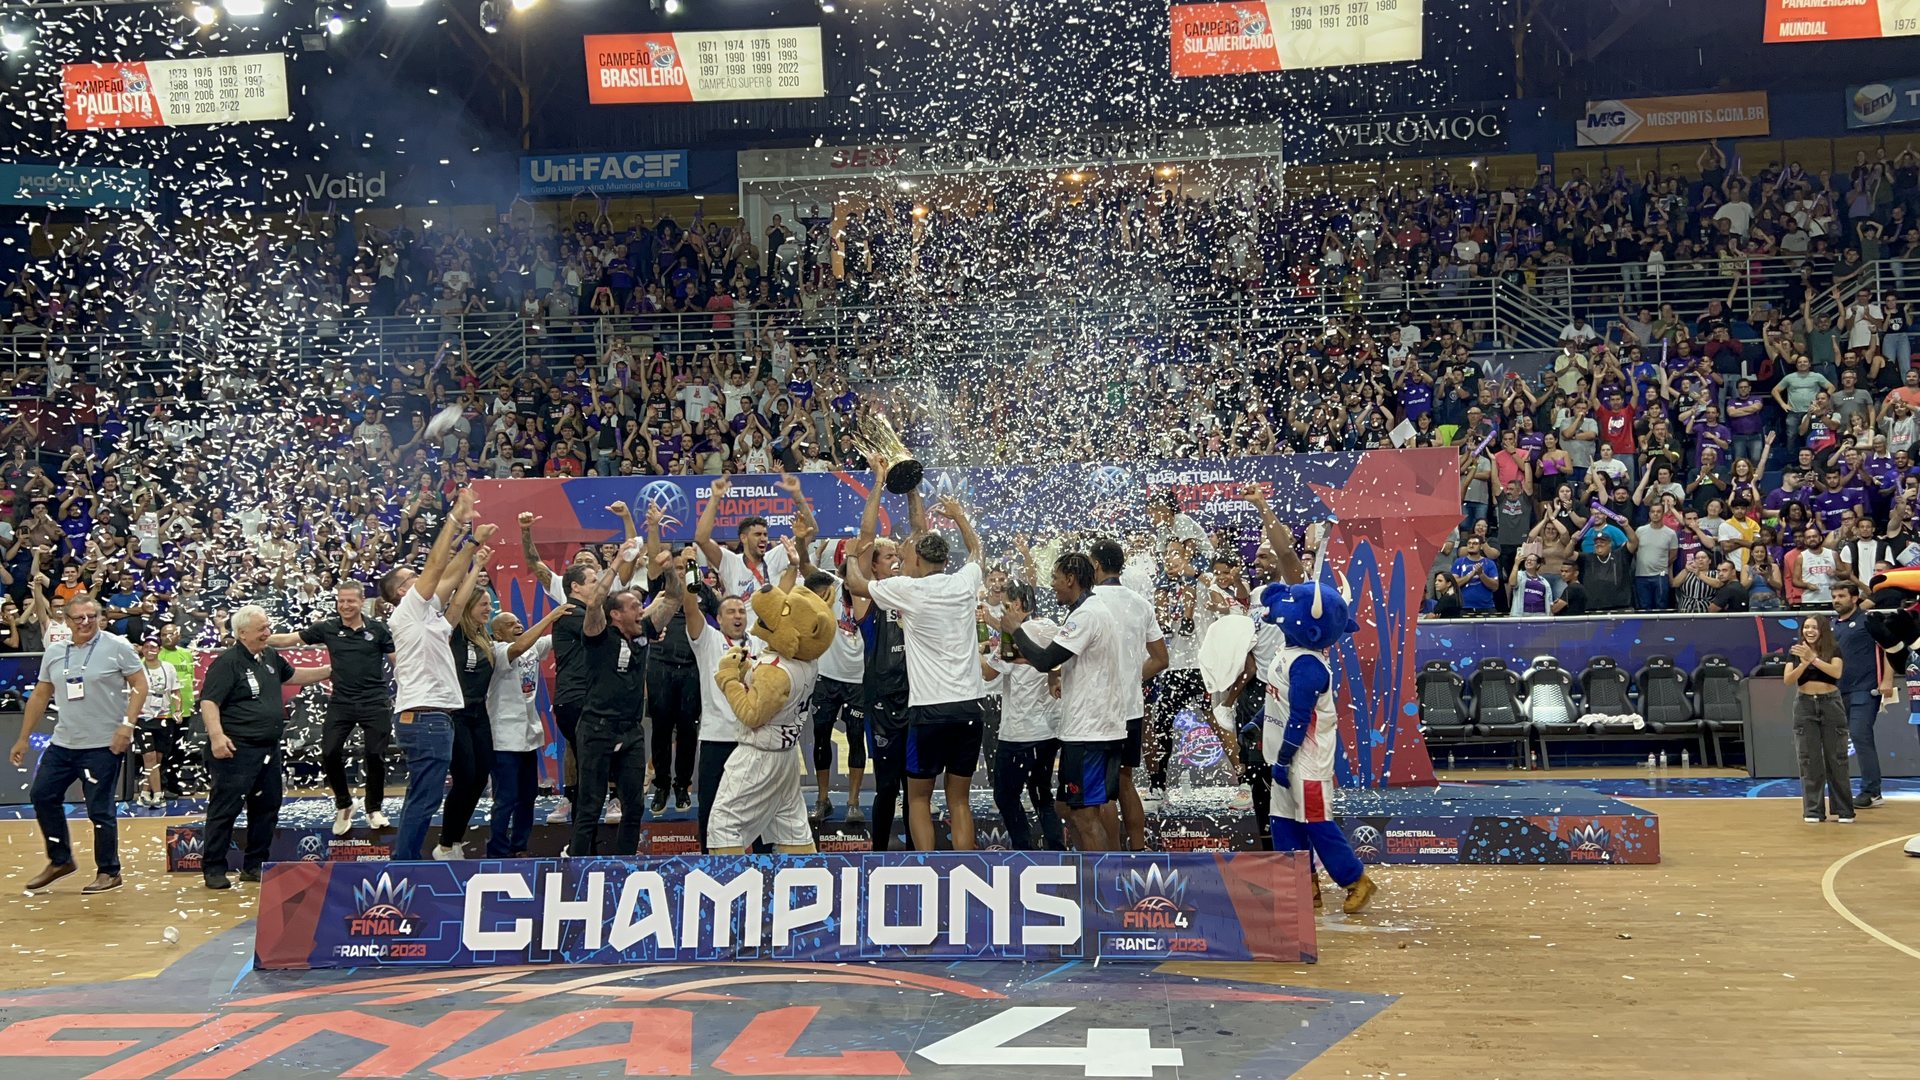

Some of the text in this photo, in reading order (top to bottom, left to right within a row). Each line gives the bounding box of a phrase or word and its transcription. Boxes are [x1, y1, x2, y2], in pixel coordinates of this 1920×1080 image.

[1291, 0, 1397, 18] 1974 1975 1977 1980
[1291, 16, 1369, 30] 1990 1991 2018
[1779, 21, 1828, 37] MUNDIAL
[1894, 18, 1916, 30] 1975
[698, 38, 797, 52] 1971 1974 1975 1980
[1184, 33, 1274, 53] SULAMERICANO
[599, 50, 650, 67] CAMPEÃO
[699, 50, 798, 64] 1981 1990 1991 1993
[193, 67, 212, 77] 1975
[218, 65, 237, 76] 1976
[243, 64, 262, 74] 1977
[699, 62, 799, 76] 1997 1998 1999 2022
[194, 78, 213, 89] 1990
[600, 67, 684, 88] BRASILEIRO
[699, 75, 799, 90] CAMPEÃO SUPER 8 2020
[194, 89, 214, 100] 2006
[219, 88, 239, 99] 2007
[244, 87, 265, 98] 2018
[77, 92, 152, 115] PAULISTA
[170, 103, 190, 114] 2019
[196, 102, 215, 113] 2020
[1647, 106, 1764, 127] MGSPORTS.COM.BR
[1333, 115, 1500, 147] VEROMOC
[530, 154, 681, 183] Uni-FACEF
[305, 171, 385, 200] Valid
[606, 181, 643, 191] Municipal
[645, 181, 655, 189] de
[695, 486, 778, 499] BAKETBALL
[652, 835, 697, 843] BASKETBALL
[819, 834, 864, 842] BASKETBALL
[1386, 830, 1436, 838] BASKETBALL
[1386, 837, 1458, 848] CHAMPIONS
[329, 846, 390, 854] CHAMPIONS
[462, 865, 1083, 951] CHAMPIONS
[332, 943, 427, 957] FRANCA 2023
[1107, 937, 1208, 952] FRANCA 2023
